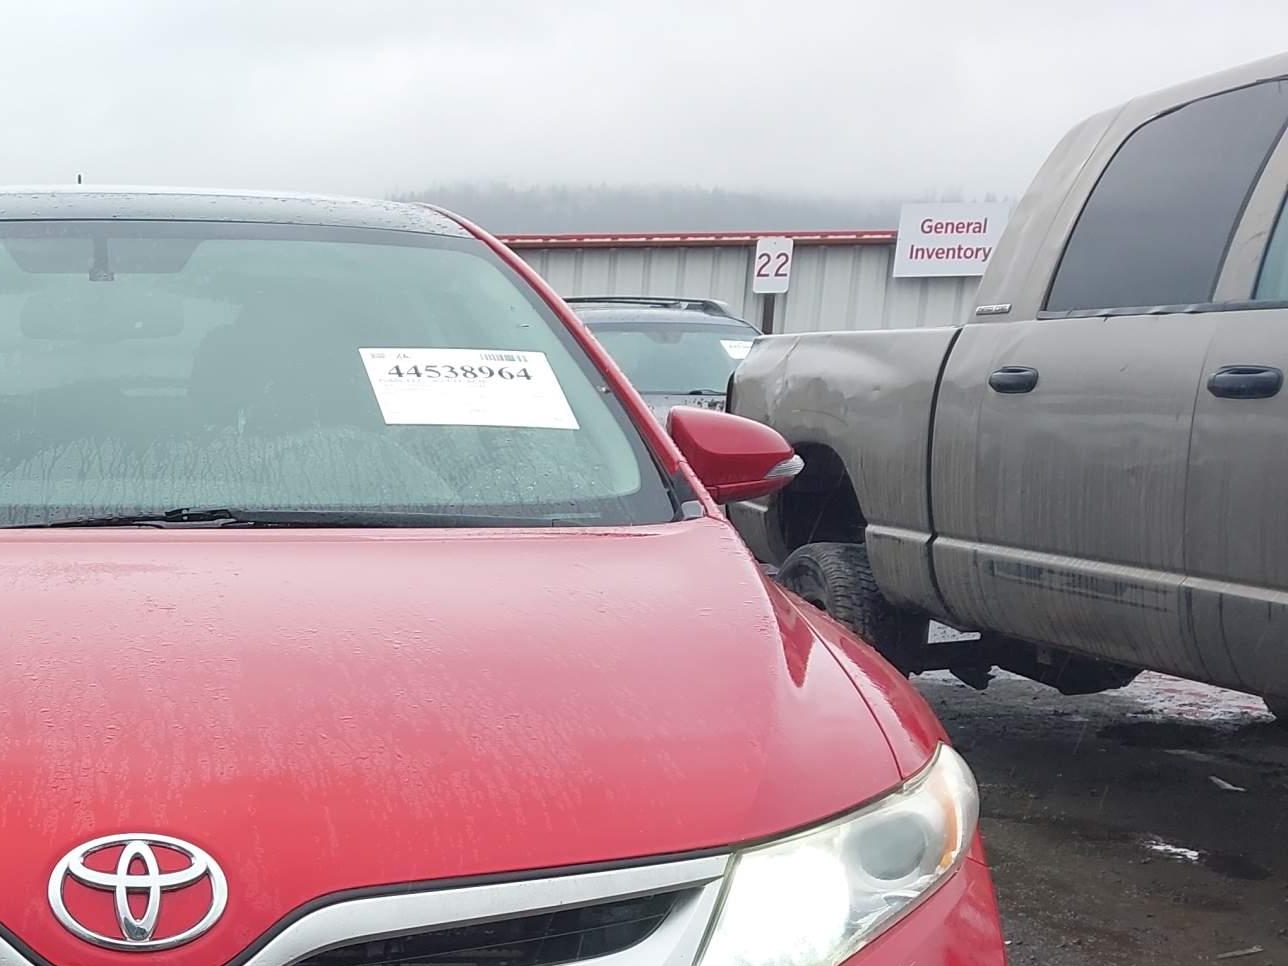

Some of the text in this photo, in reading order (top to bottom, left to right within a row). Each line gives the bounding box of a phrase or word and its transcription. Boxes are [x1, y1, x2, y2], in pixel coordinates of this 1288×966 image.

[920, 217, 988, 235] General
[909, 244, 993, 263] Inventory
[756, 252, 790, 277] 22
[387, 364, 533, 381] 44538964
